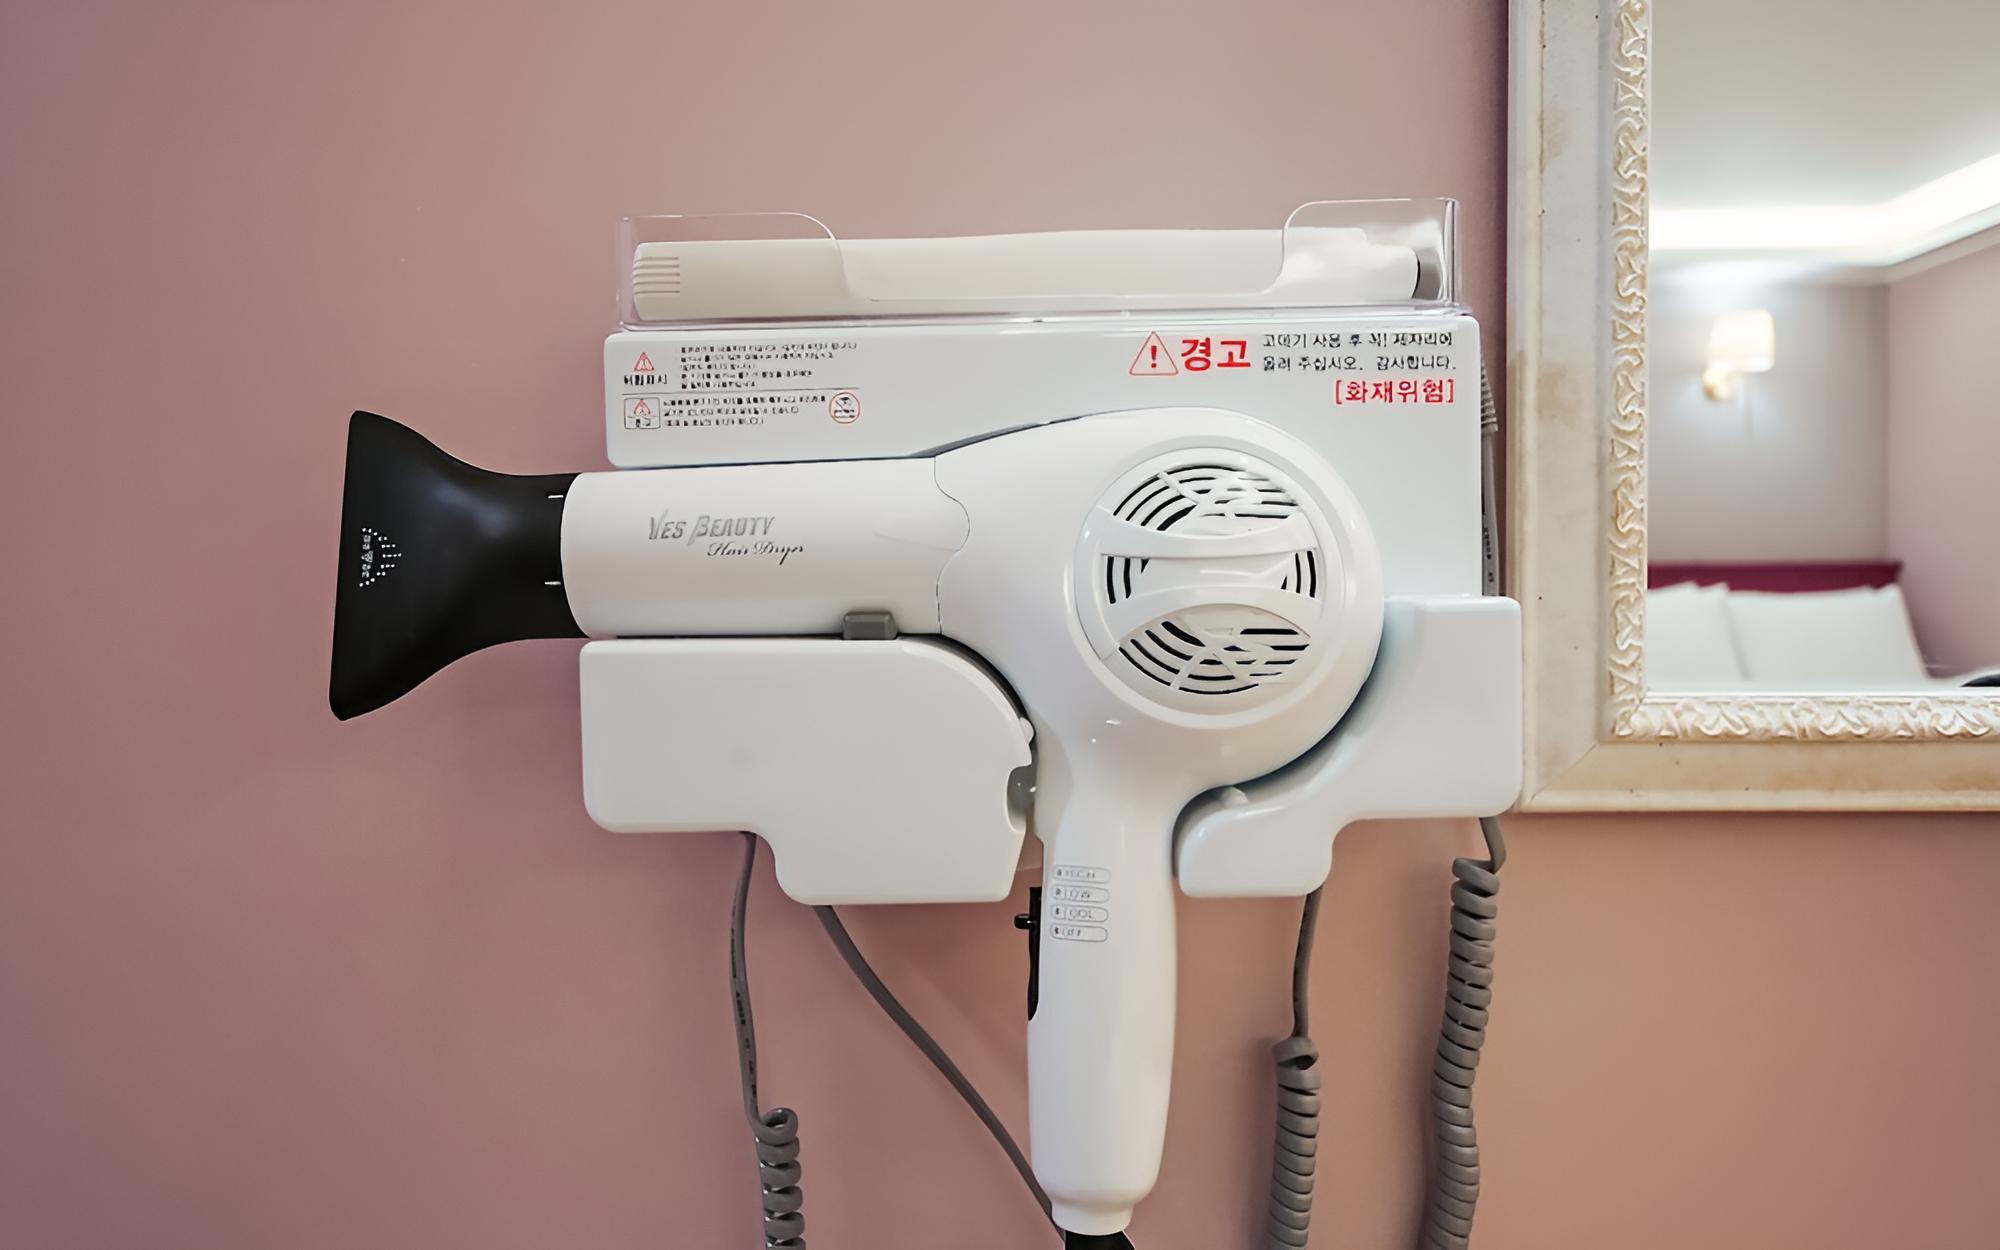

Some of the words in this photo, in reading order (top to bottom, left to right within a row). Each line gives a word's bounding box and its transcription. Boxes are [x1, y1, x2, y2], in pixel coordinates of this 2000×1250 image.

[1312, 333, 1342, 349] 사용
[1180, 336, 1252, 372] 경고
[1376, 354, 1457, 371] 감사합니다.
[1335, 378, 1454, 405] [화재위험]
